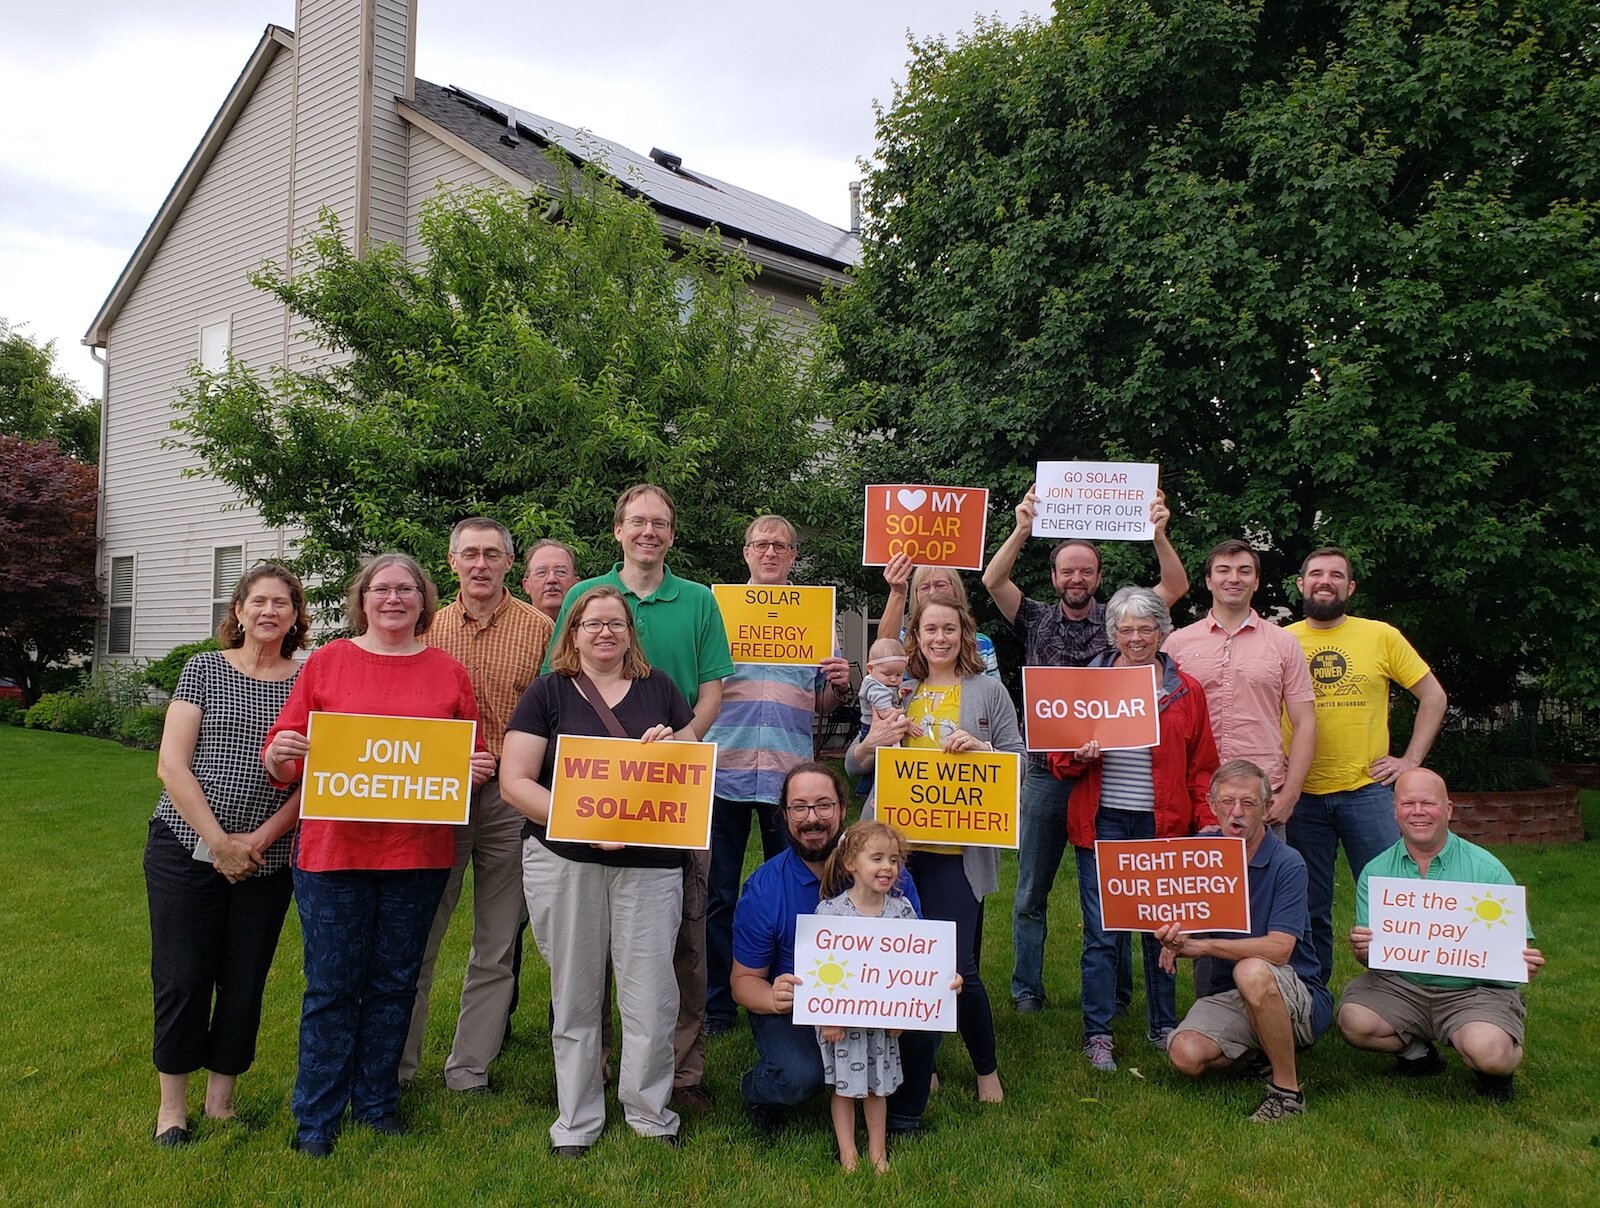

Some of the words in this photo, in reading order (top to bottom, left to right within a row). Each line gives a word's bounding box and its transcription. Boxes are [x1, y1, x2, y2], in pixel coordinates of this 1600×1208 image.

[1064, 472, 1082, 482] GO
[1086, 473, 1128, 484] SOLAR
[885, 490, 891, 511] I
[931, 491, 968, 513] MY
[1045, 488, 1073, 498] JOIN
[1077, 489, 1144, 500] TOGETHER
[1047, 504, 1082, 514] FIGHT
[1086, 505, 1111, 515] FOR
[1115, 506, 1142, 516] OUR
[885, 514, 961, 538] SOLAR
[1041, 519, 1092, 530] ENERGY
[1095, 521, 1146, 532] RIGHTS!
[888, 538, 957, 561] CO-OP
[745, 590, 800, 606] SOLAR
[739, 625, 808, 641] ENERGY
[731, 642, 813, 659] FREEDOM
[1314, 666, 1342, 678] POWER
[1035, 699, 1068, 719] GO
[1073, 698, 1146, 719] SOLAR
[358, 739, 421, 765] JOIN
[564, 757, 610, 780] WE
[620, 760, 707, 785] WENT
[895, 760, 929, 780] WE
[936, 762, 1001, 783] WENT
[313, 771, 460, 801] TOGETHER
[910, 784, 983, 806] SOLAR
[576, 796, 687, 824] SOLAR!
[883, 806, 1009, 832] TOGETHER!
[1118, 852, 1177, 872] FIGHT
[1182, 850, 1224, 869] FOR
[1107, 878, 1151, 897] OUR
[1156, 876, 1238, 897] ENERGY
[1382, 888, 1416, 908] Let
[1422, 892, 1458, 911] the
[1137, 901, 1211, 922] RIGHTS
[815, 928, 875, 952] Grow
[879, 933, 937, 955] solar
[1382, 918, 1421, 936] sun
[1428, 924, 1469, 943] pay
[1382, 945, 1431, 963] your
[1436, 947, 1488, 968] bills!
[860, 963, 880, 984] in
[886, 968, 939, 989] your
[807, 996, 943, 1022] community!
